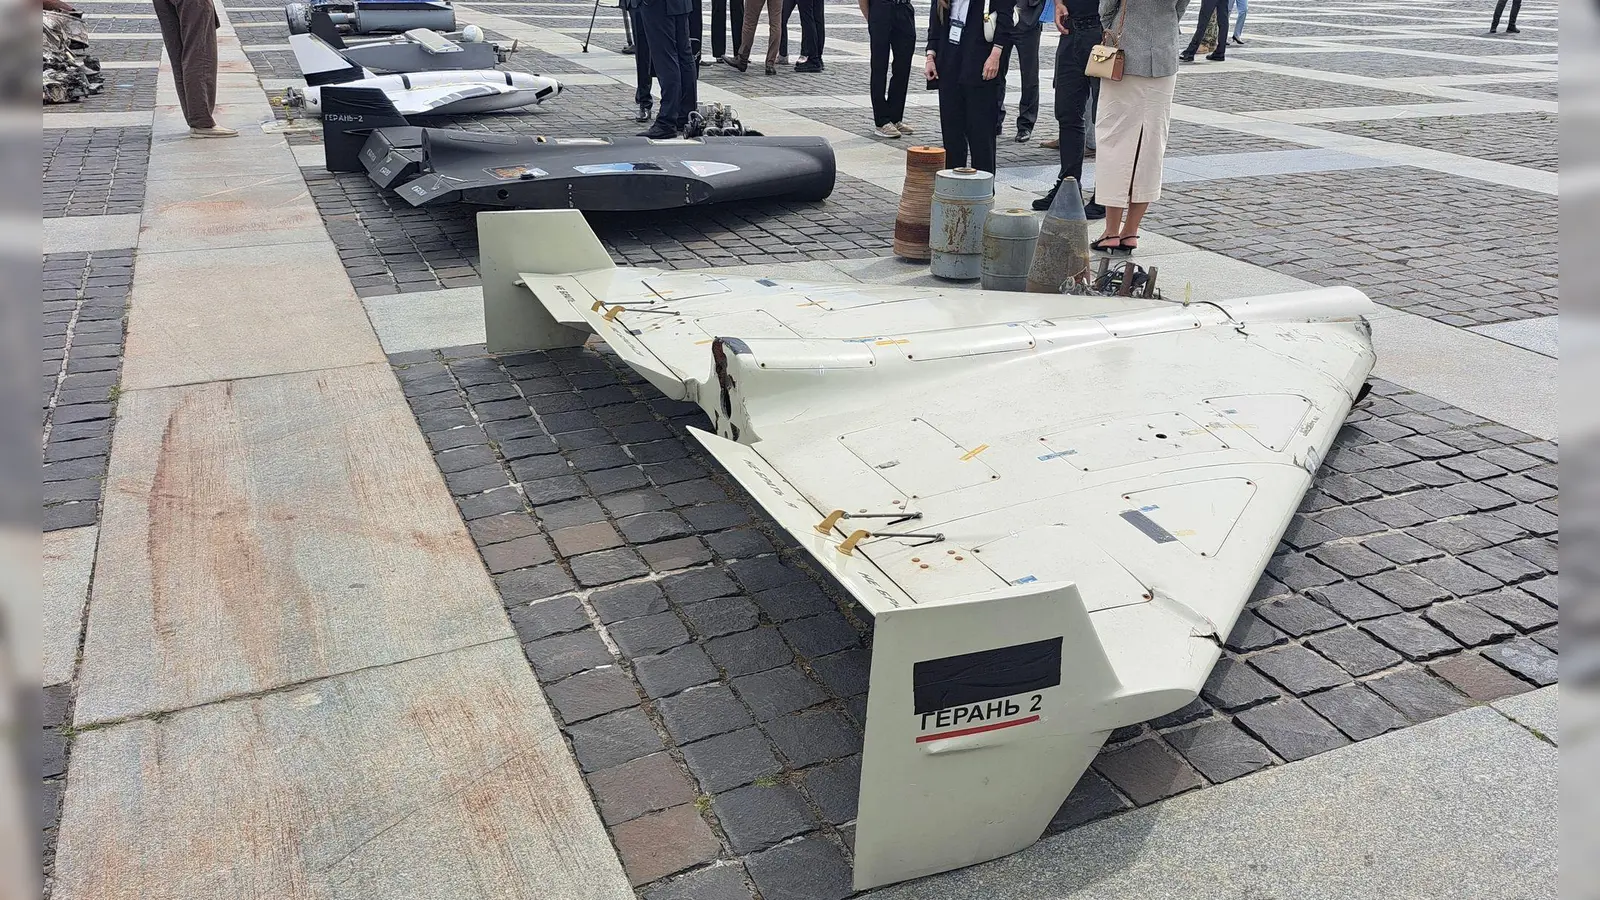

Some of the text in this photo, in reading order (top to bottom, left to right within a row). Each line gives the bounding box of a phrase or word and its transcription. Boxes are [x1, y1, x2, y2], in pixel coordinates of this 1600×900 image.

[324, 113, 364, 123] ГЕРАНЬ-2
[920, 694, 1043, 731] ГЕРАНЬ 2
